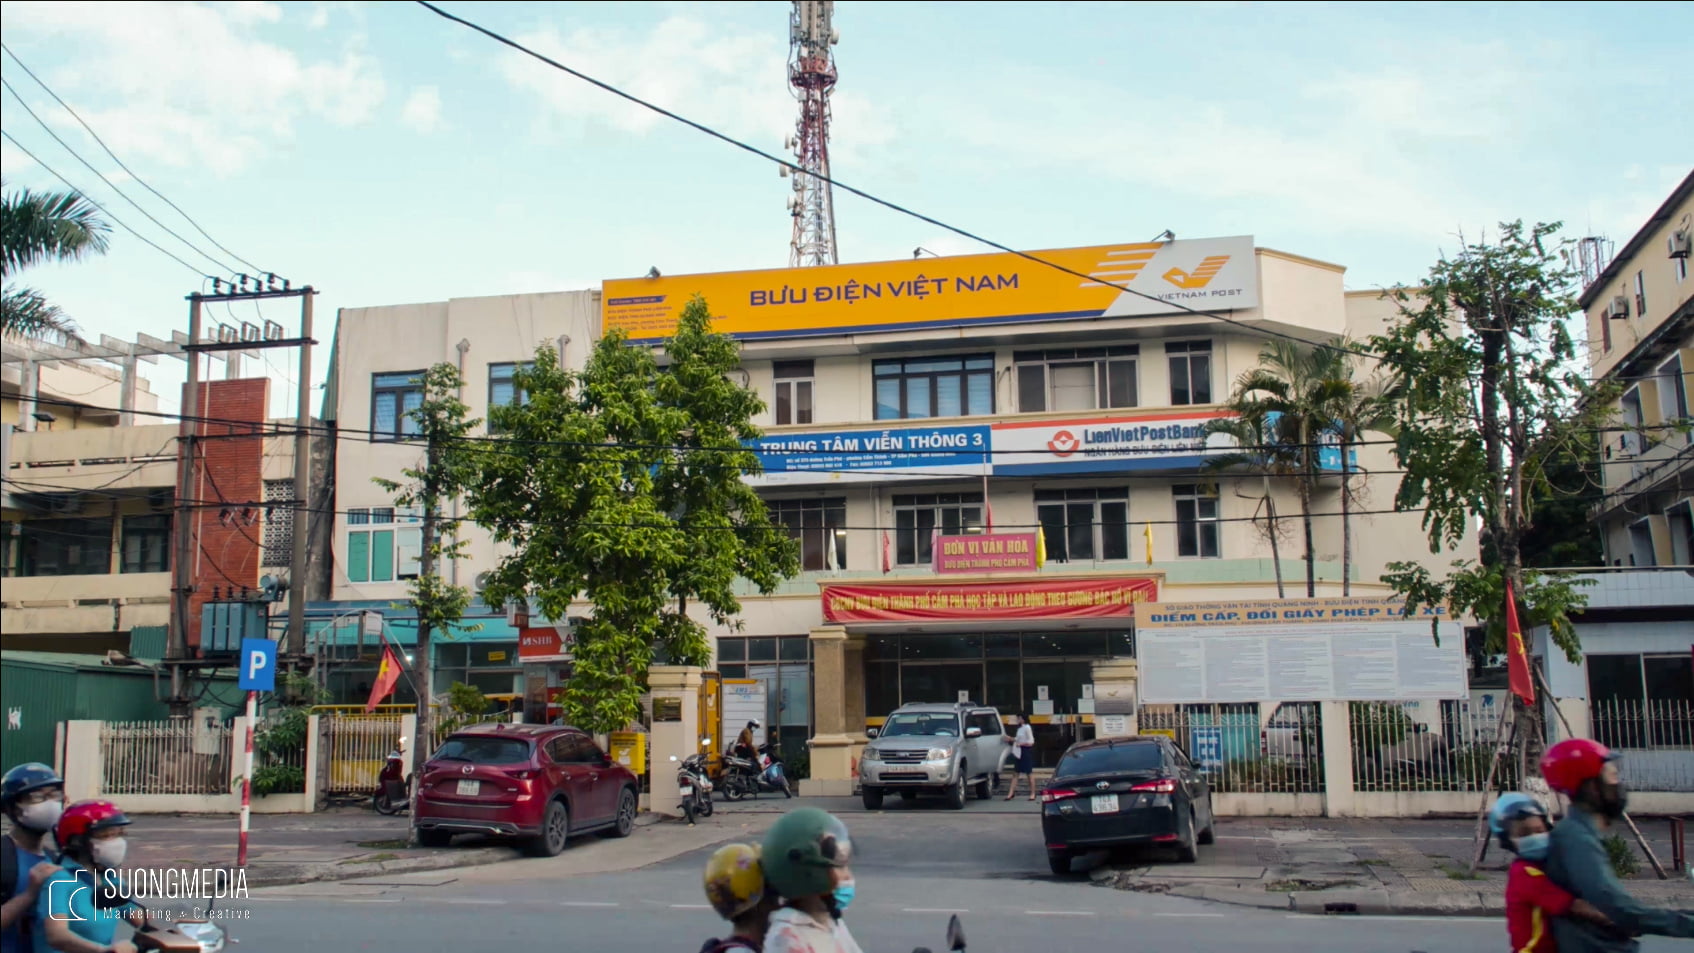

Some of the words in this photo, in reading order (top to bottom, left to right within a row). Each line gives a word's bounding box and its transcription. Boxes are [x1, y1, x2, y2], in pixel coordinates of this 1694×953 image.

[750, 285, 807, 306] BƯU
[813, 280, 881, 304] ĐIỆN
[887, 274, 948, 300] VIỆT
[956, 273, 1019, 293] NAM
[1157, 291, 1207, 300] VIETNAM
[760, 440, 817, 455] TRUNG
[821, 436, 859, 452] TÂM
[864, 431, 903, 451] VIỄN
[908, 432, 967, 449] THÔNG
[972, 433, 983, 446] 3
[944, 540, 965, 555] ĐƠN
[968, 541, 979, 557] VỊ
[1151, 611, 1196, 622] ĐIỂM
[1247, 607, 1277, 620] ĐỔI
[1284, 607, 1325, 619] GIẤY
[1423, 606, 1446, 616] XE
[532, 636, 552, 645] SHB
[249, 650, 267, 680] P
